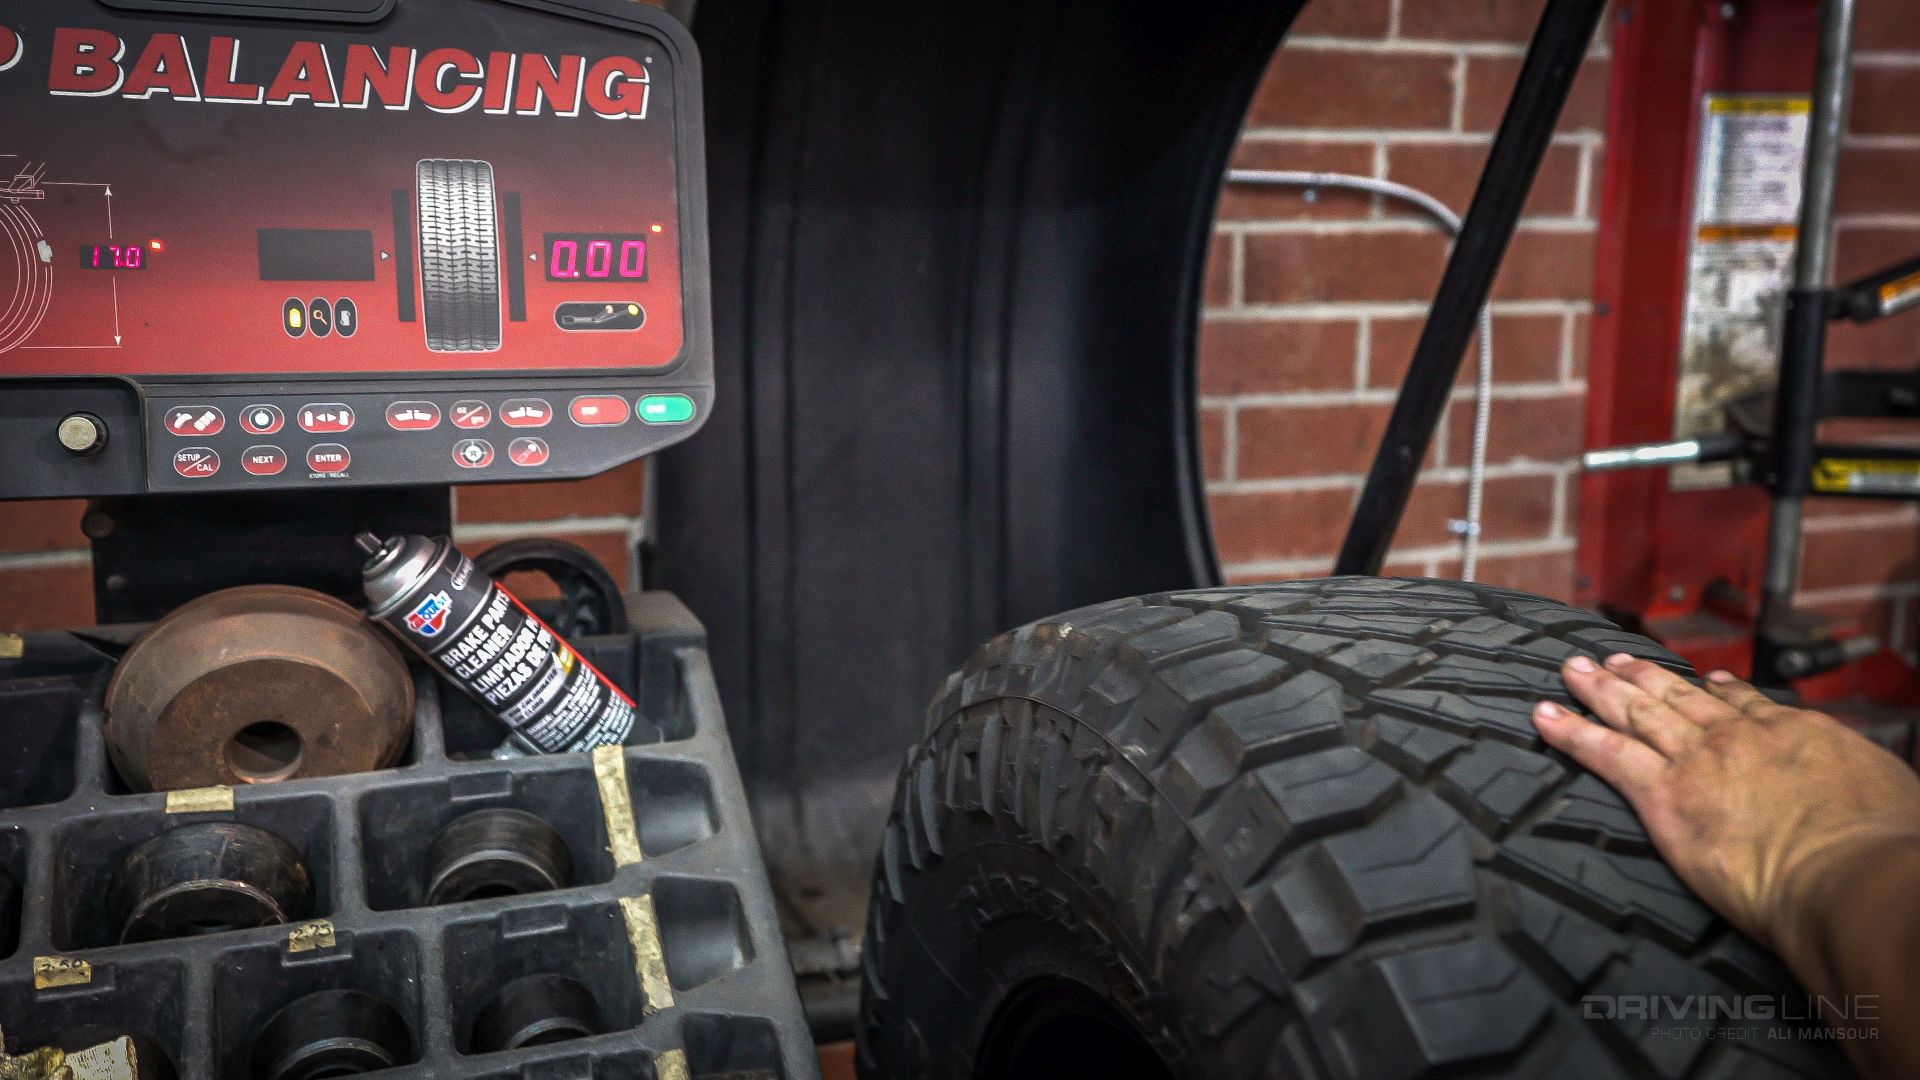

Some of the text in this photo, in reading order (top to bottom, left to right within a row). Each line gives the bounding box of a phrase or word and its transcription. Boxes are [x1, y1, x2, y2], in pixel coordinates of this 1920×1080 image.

[48, 27, 650, 120] BALANCING
[92, 245, 142, 268] 17.0
[550, 240, 646, 278] 0.00
[177, 453, 201, 462] SETUP
[196, 463, 214, 472] CAL
[252, 455, 274, 464] NEXT
[315, 454, 342, 463] ENTER
[440, 625, 489, 668] BRAKE
[455, 624, 513, 679] CLEANER
[471, 626, 536, 693] LIMPIADOR
[484, 662, 533, 705] PIEZAS
[525, 643, 547, 667] DE
